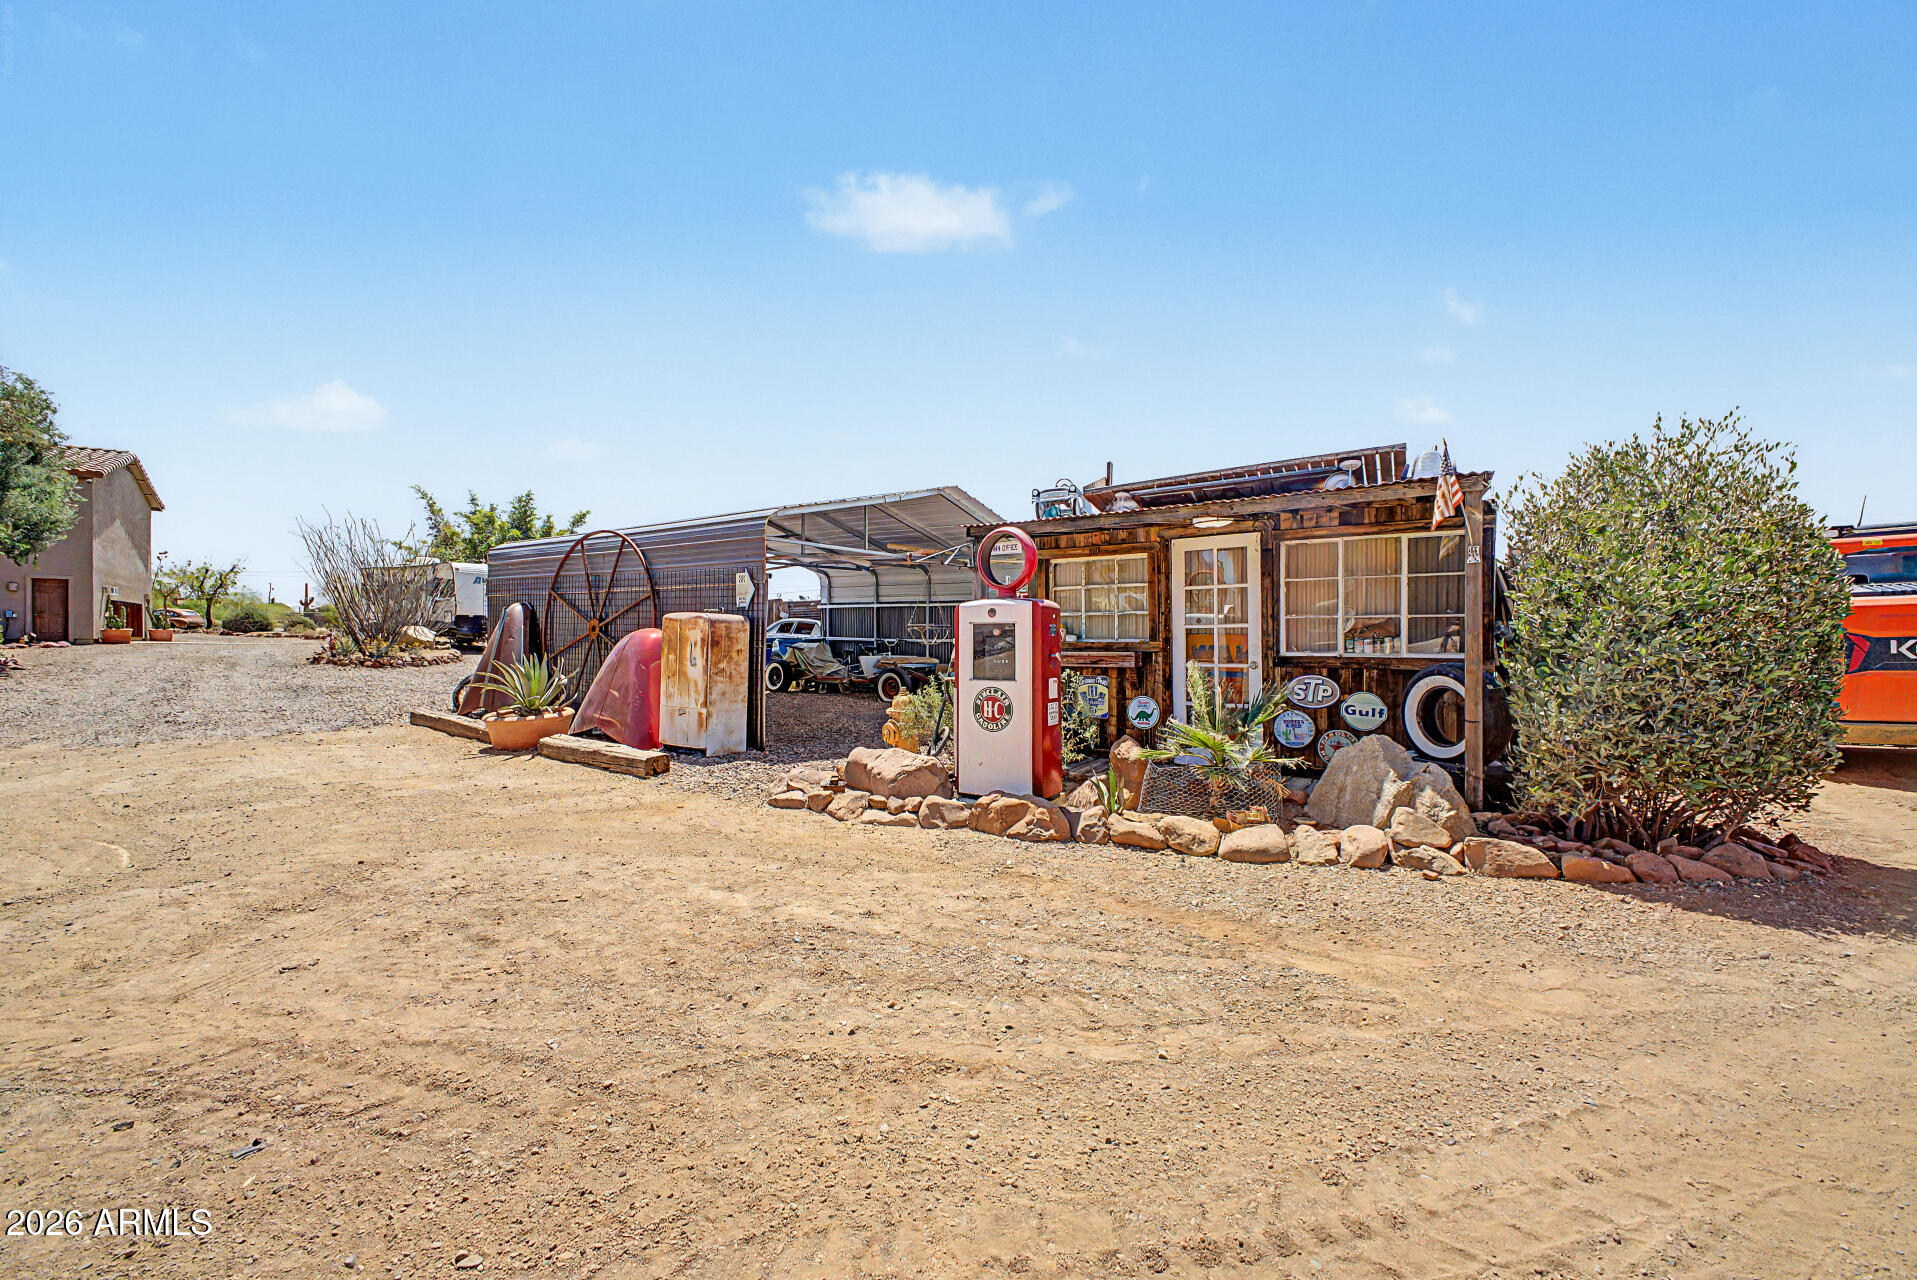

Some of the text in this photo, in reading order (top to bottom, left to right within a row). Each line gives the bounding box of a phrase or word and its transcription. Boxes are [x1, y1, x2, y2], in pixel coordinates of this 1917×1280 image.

[1890, 639, 1917, 659] K
[976, 689, 1010, 706] SINCLAIR
[1293, 679, 1333, 703] STP
[1344, 704, 1386, 718] Gulf
[976, 712, 1011, 730] GASOLINE
